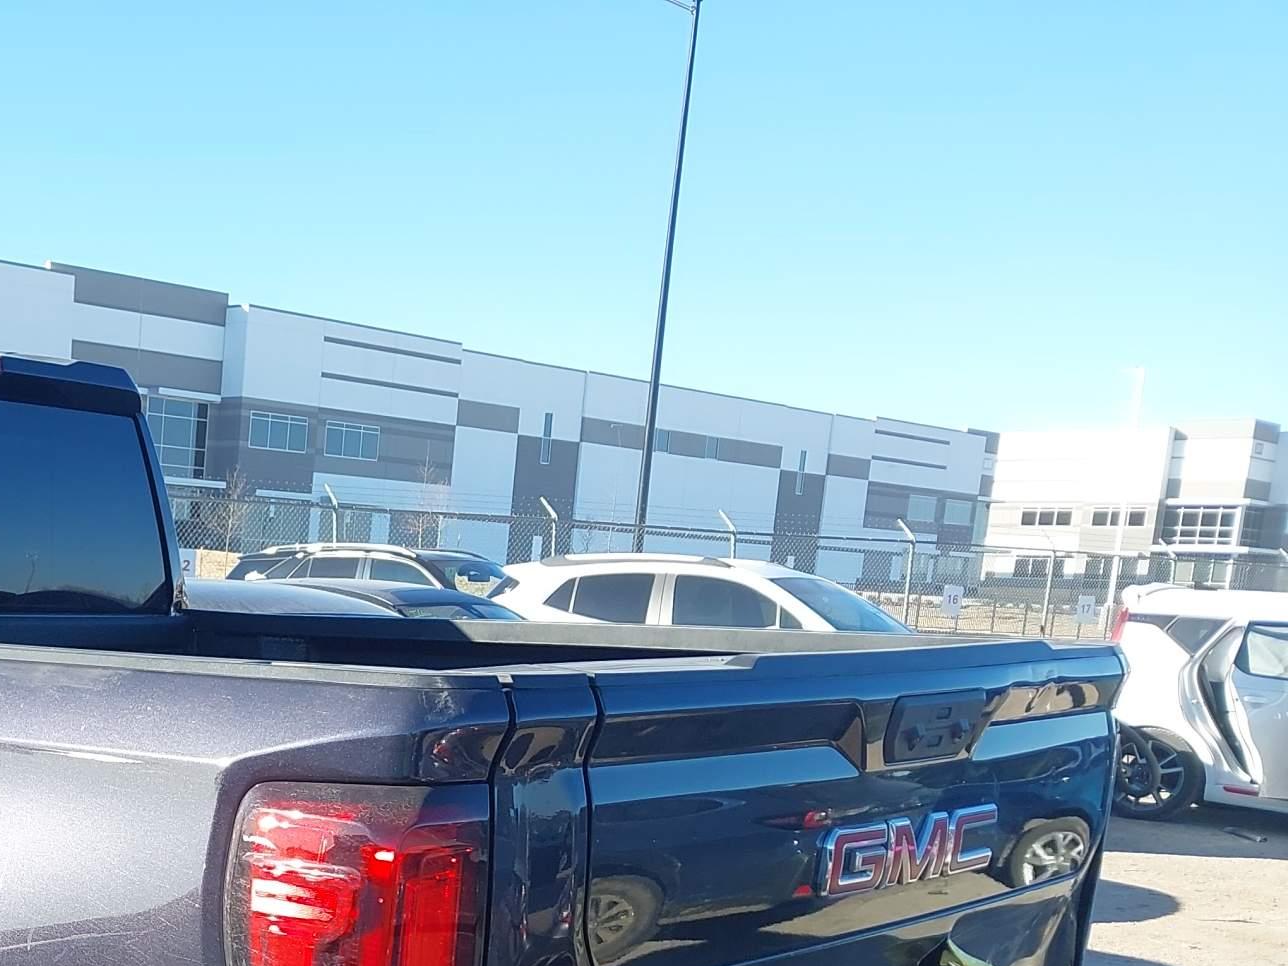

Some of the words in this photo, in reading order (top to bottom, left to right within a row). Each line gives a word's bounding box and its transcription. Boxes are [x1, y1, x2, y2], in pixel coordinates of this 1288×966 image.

[947, 594, 959, 605] 16
[1081, 604, 1092, 614] 17
[817, 803, 999, 896] GMC
